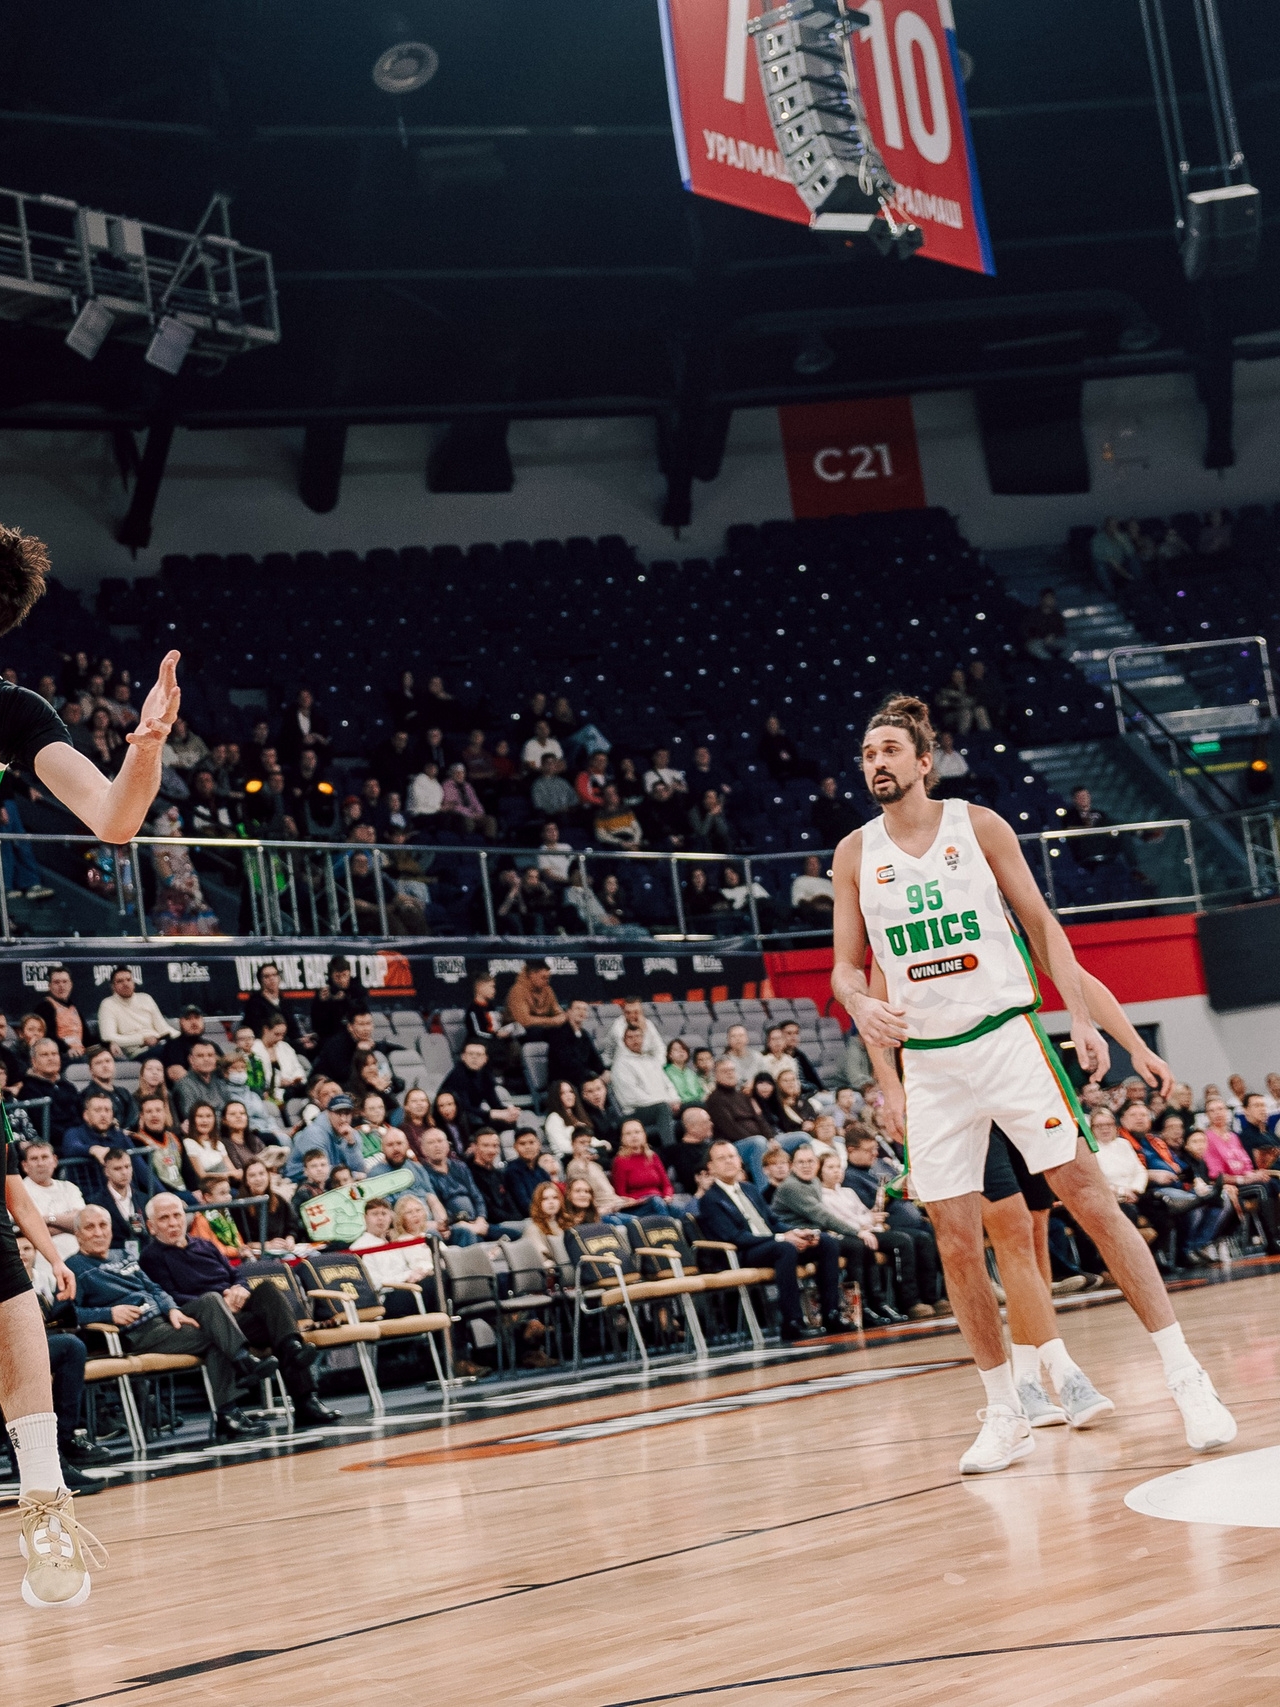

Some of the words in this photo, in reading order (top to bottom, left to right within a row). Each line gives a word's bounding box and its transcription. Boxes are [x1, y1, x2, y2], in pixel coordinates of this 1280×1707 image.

[859, 0, 951, 164] 10
[813, 443, 893, 482] C21
[906, 880, 943, 915] 95
[885, 910, 981, 957] UNICS
[910, 959, 963, 980] WINLINE
